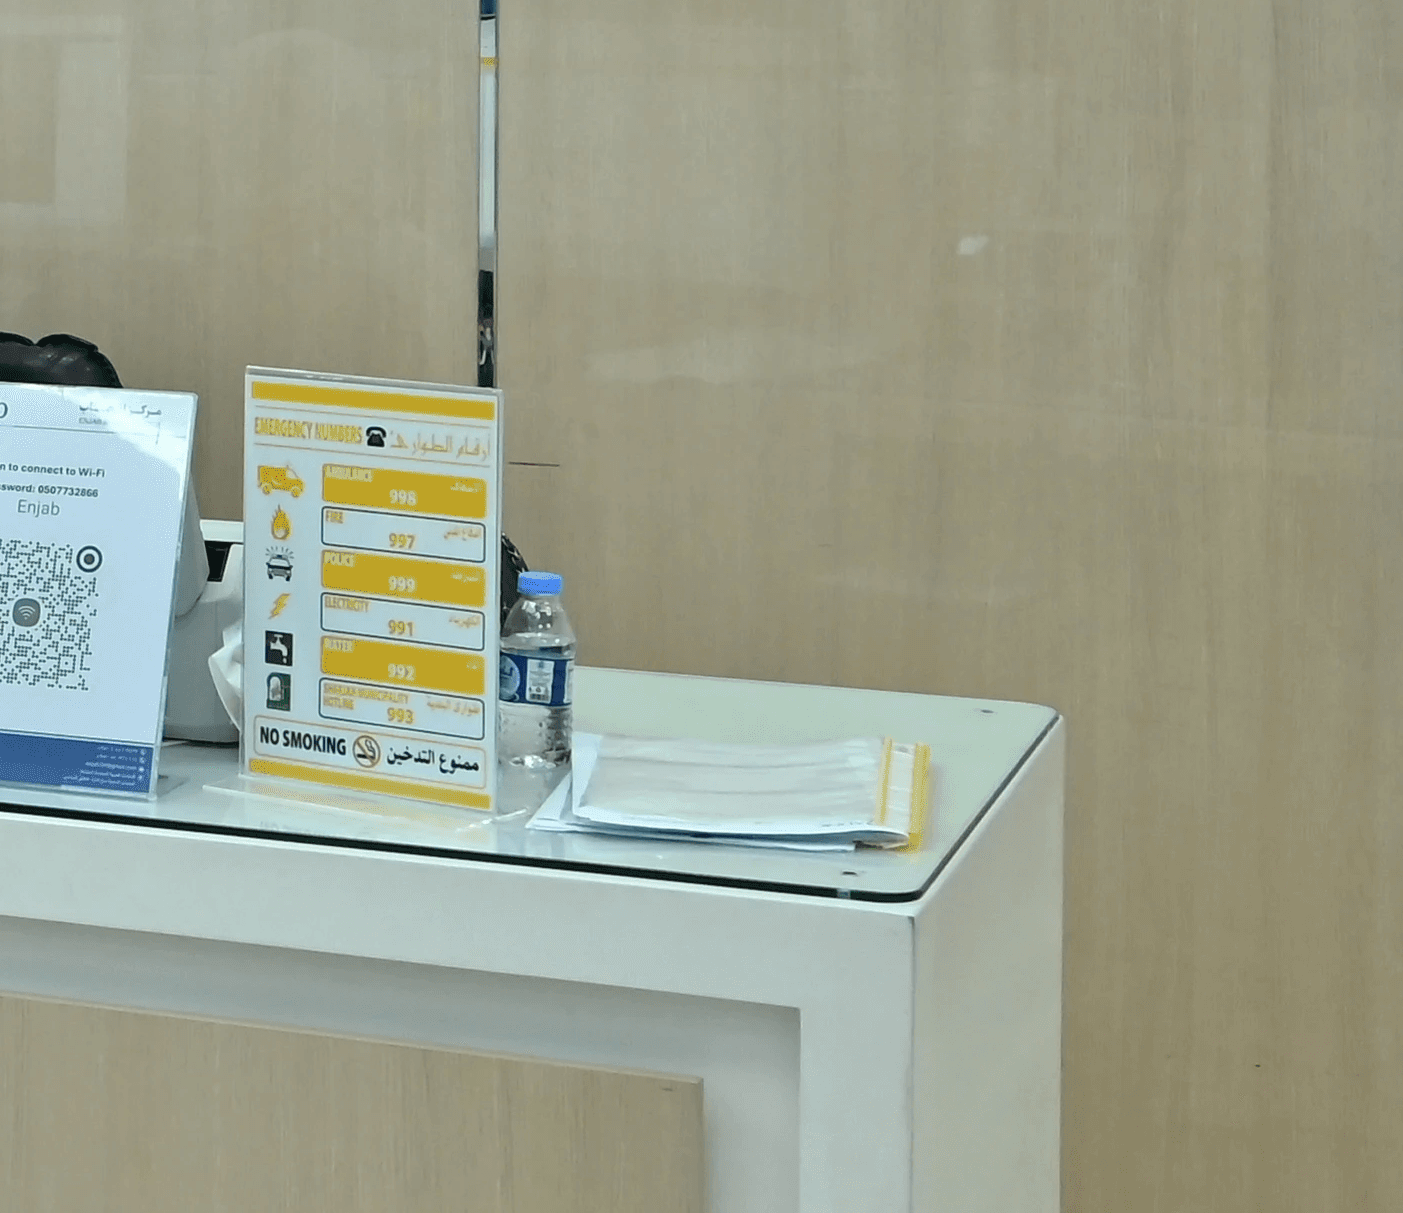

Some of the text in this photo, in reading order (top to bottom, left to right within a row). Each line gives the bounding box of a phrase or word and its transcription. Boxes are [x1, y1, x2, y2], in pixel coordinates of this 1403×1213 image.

[130, 404, 162, 419] مرك
[255, 417, 314, 439] EMERGENCY
[8, 462, 19, 472] to
[21, 464, 63, 475] connect
[65, 466, 76, 476] to
[78, 467, 105, 478] Wi-Fi
[17, 499, 60, 518] Enjab
[389, 533, 416, 550] 997
[388, 575, 416, 592] 999
[388, 620, 414, 636] 991
[387, 707, 414, 725] 993
[259, 726, 346, 755] NO SMOKING
[387, 746, 479, 774] ممنوع التدخين
